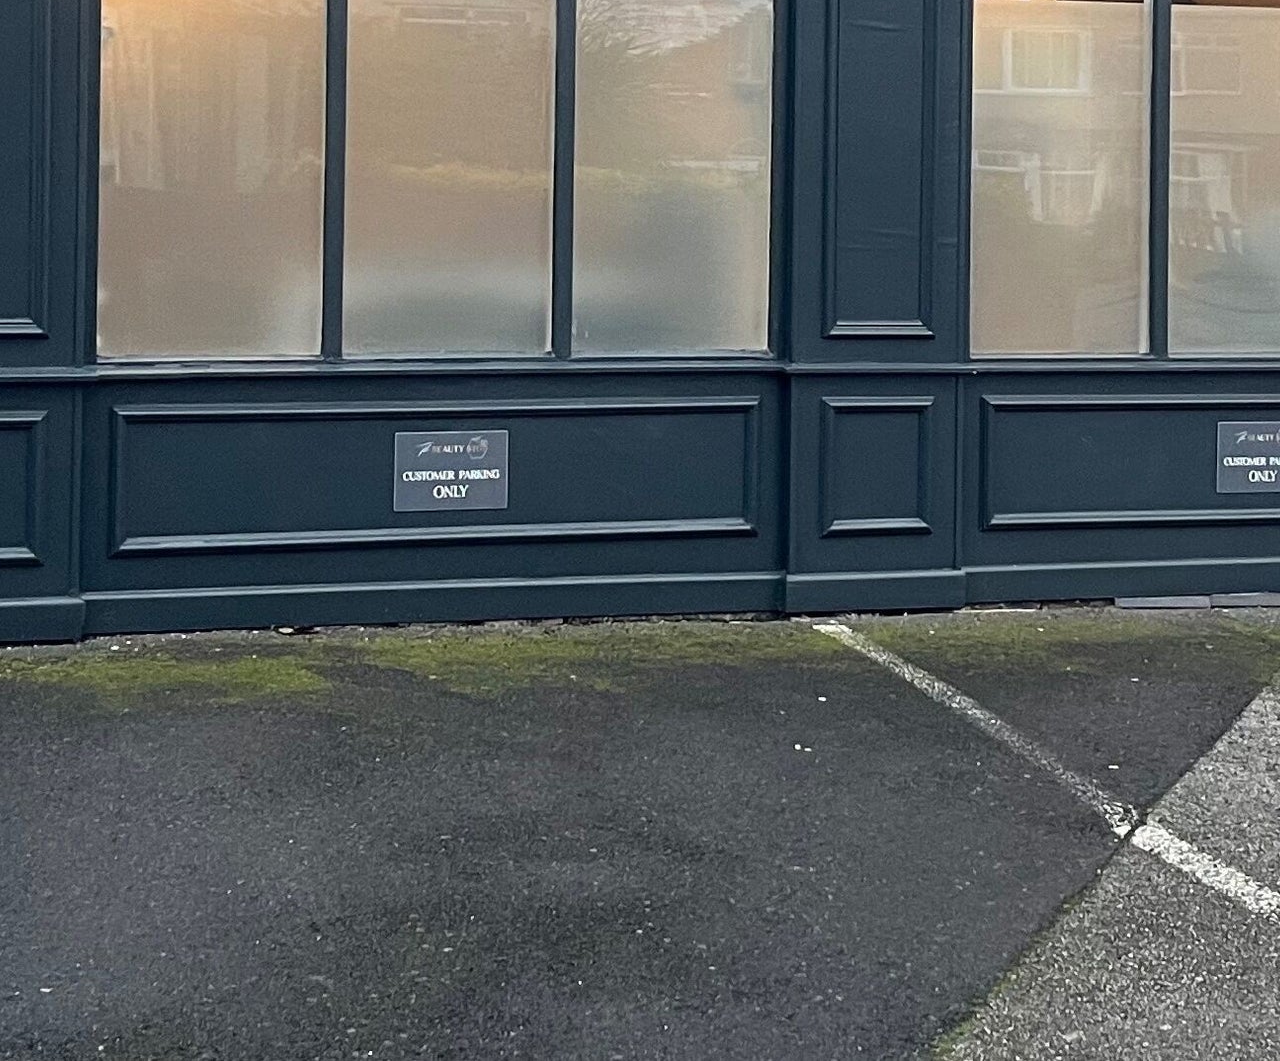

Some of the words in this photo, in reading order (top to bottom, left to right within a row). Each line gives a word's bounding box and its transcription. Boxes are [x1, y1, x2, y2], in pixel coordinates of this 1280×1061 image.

[1223, 457, 1267, 467] CUSTOMER
[402, 470, 455, 482] CUSTOMER
[458, 469, 500, 480] PARKING
[1248, 469, 1278, 483] ONLY
[432, 484, 469, 499] ONLY
